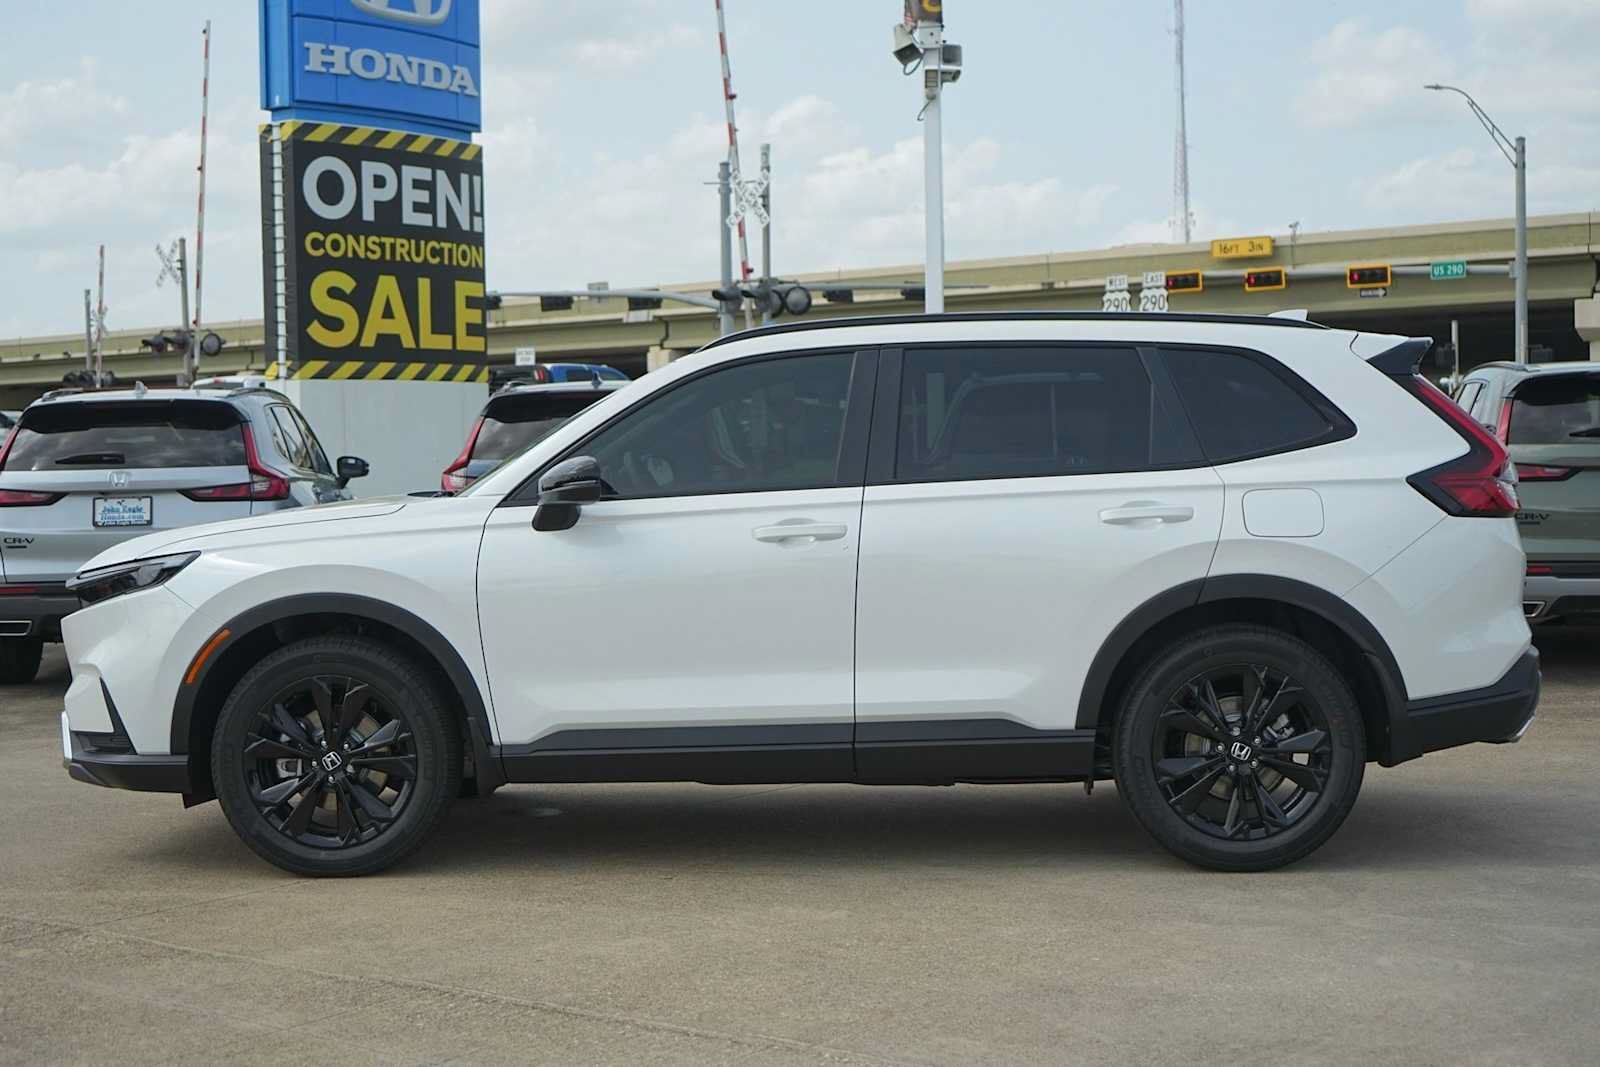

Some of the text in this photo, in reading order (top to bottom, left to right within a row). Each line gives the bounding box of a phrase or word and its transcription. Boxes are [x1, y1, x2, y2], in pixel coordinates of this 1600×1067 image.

[303, 41, 479, 97] HONDA
[302, 155, 484, 233] OPEN!
[304, 231, 484, 269] CONSTRUCTION
[1433, 263, 1464, 276] US 290
[306, 270, 485, 352] SALE
[1105, 297, 1128, 312] 290
[1142, 295, 1165, 311] 290
